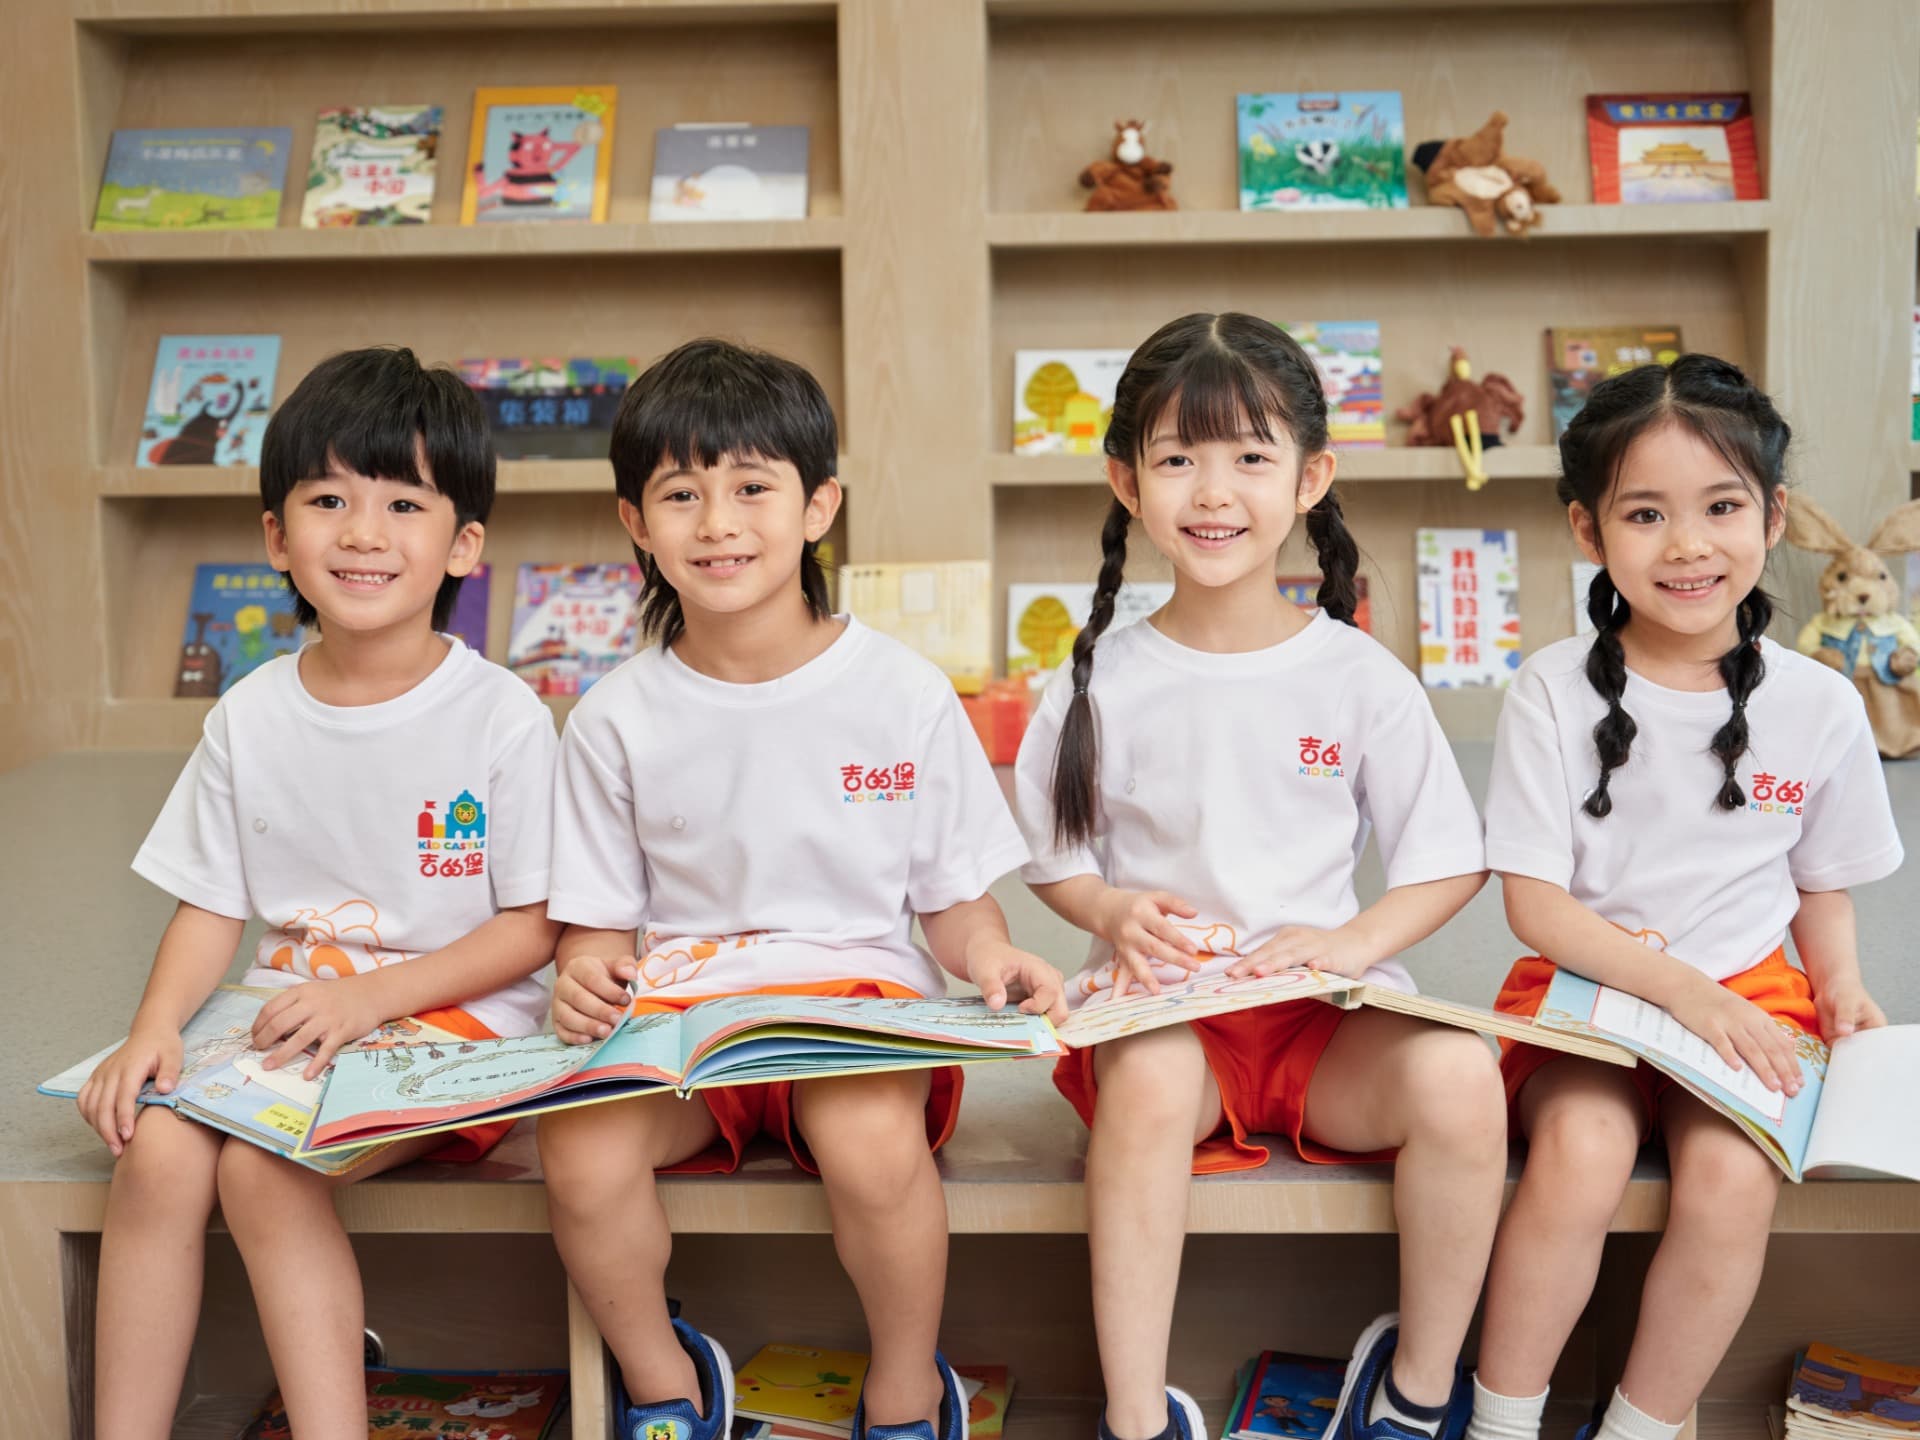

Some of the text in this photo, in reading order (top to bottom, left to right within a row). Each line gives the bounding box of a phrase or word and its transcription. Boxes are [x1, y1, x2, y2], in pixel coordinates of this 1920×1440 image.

[1451, 548, 1479, 664] 我们的城市
[840, 762, 915, 792] 吉的堡
[1298, 766, 1320, 776] KID
[1752, 772, 1808, 803] 吉的
[844, 791, 915, 803] KID CASTLE
[1750, 802, 1773, 813] KID
[417, 840, 441, 850] KID
[418, 852, 484, 877] 吉的堡
